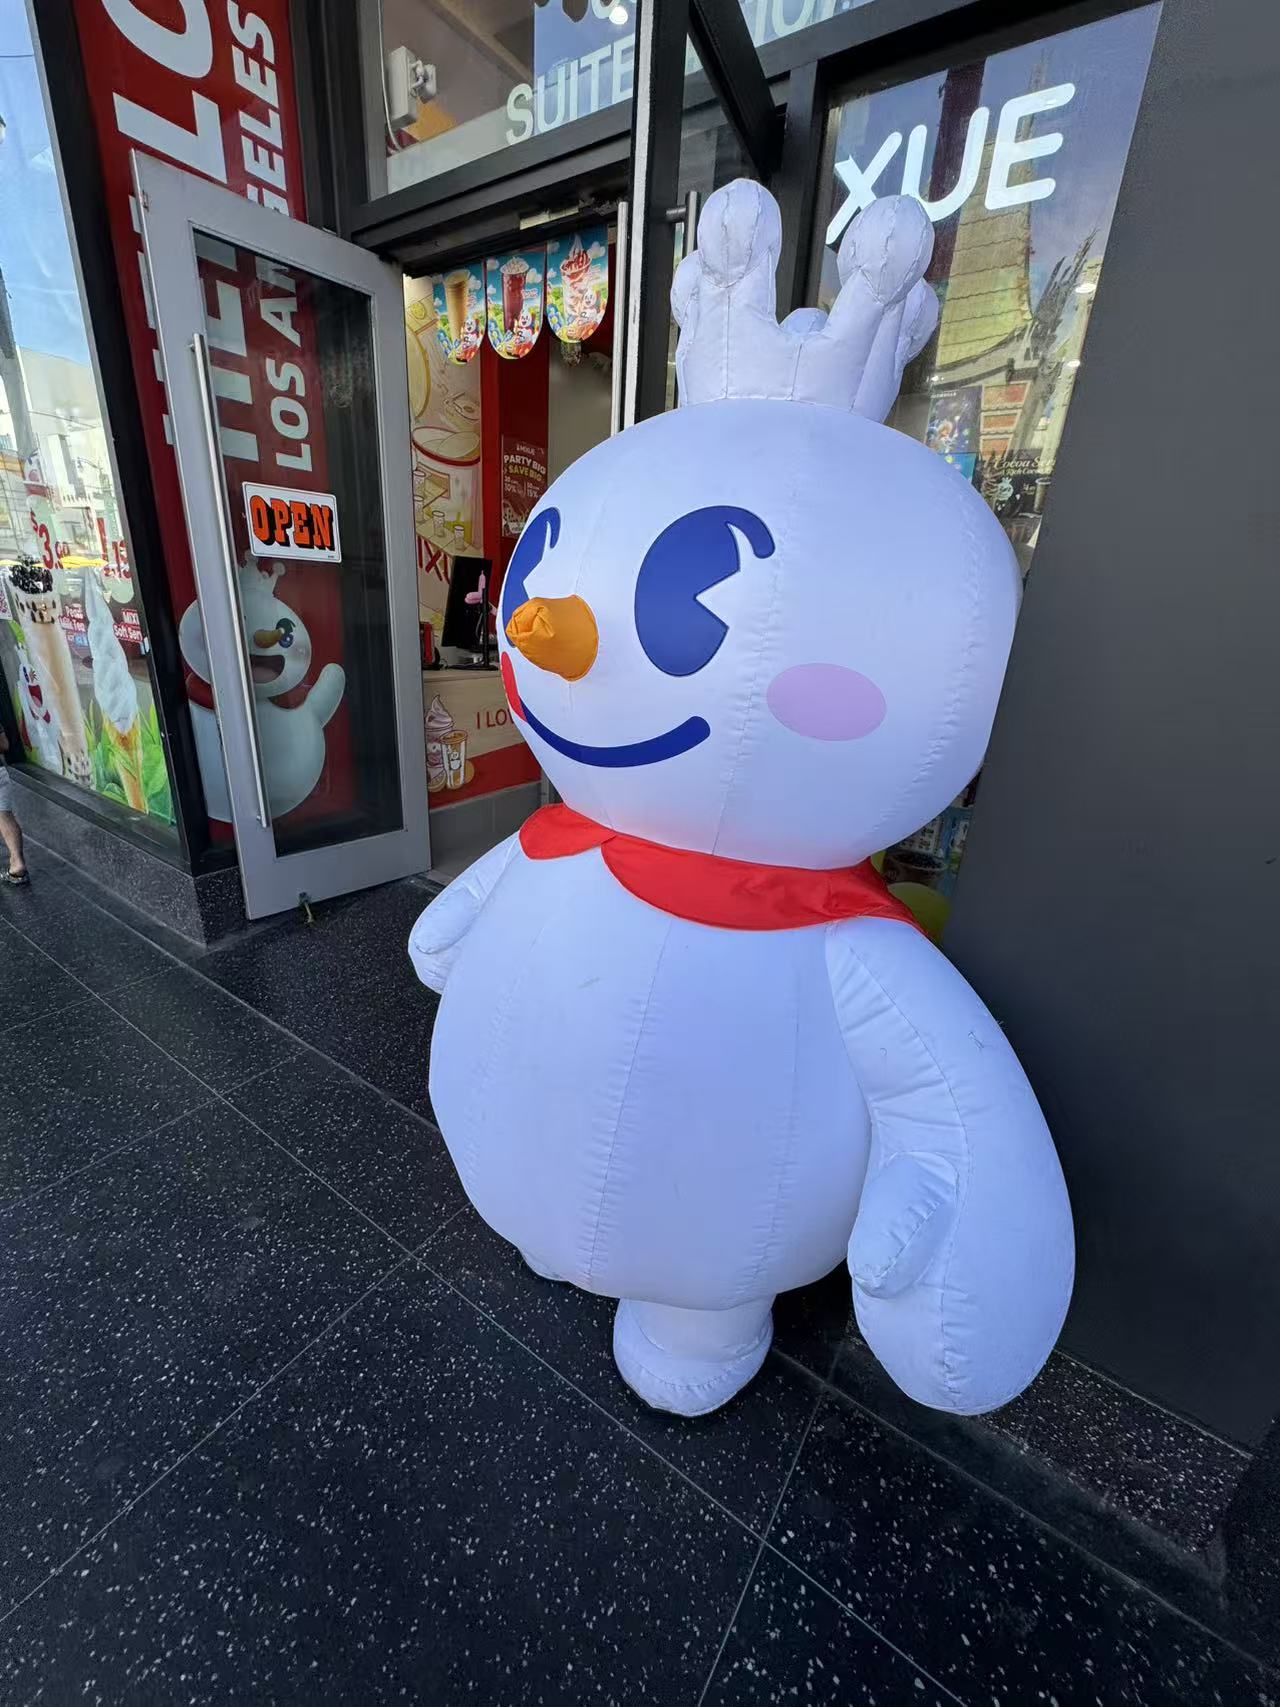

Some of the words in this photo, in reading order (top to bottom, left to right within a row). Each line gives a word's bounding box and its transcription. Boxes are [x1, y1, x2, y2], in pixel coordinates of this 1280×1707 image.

[505, 33, 635, 147] SUITE
[825, 82, 1076, 246] XUE
[265, 357, 313, 472] LOS
[503, 455, 532, 466] PARTY
[532, 460, 546, 475] BIG
[508, 464, 529, 476] SAVE
[529, 469, 543, 482] BIG
[994, 455, 1030, 470] Cocoa
[248, 495, 336, 552] OPEN
[476, 711, 481, 730] I
